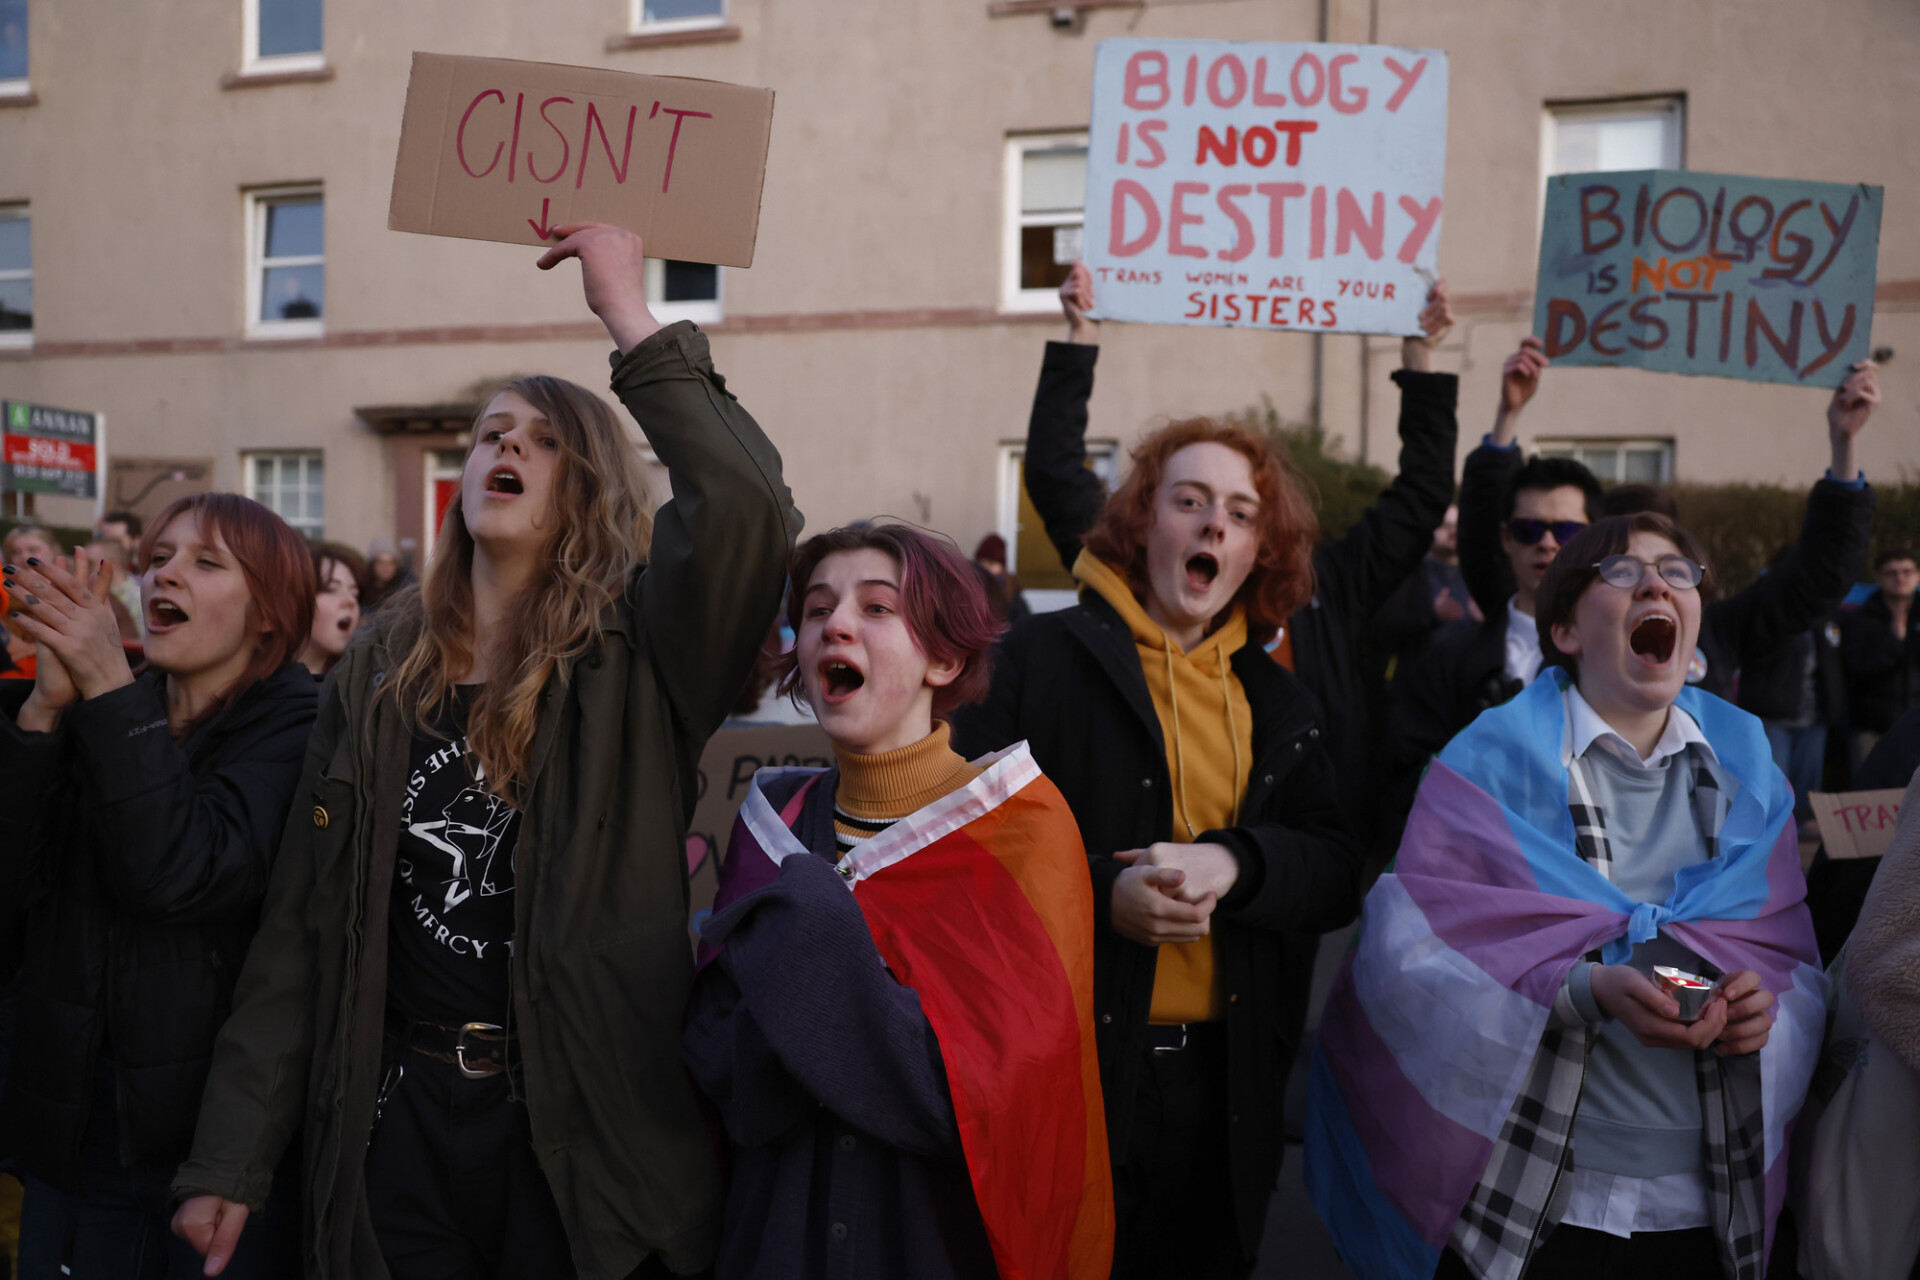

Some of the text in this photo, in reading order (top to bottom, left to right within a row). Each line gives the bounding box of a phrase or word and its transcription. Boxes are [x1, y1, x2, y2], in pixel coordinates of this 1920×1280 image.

[1122, 50, 1428, 115] BIOLOGY
[456, 88, 713, 194] CISN'T
[1116, 119, 1319, 169] IS NOT
[1108, 178, 1442, 264] DESTINY
[1579, 184, 1860, 287] BIOLOGY
[1097, 268, 1396, 301] TRANS WOMEN ARE YOUR
[1587, 255, 1733, 294] IS NOT
[1184, 291, 1337, 328] SISTERS
[1545, 291, 1857, 380] DESTINY
[400, 769, 426, 828] SIST
[411, 893, 489, 959] MERCY
